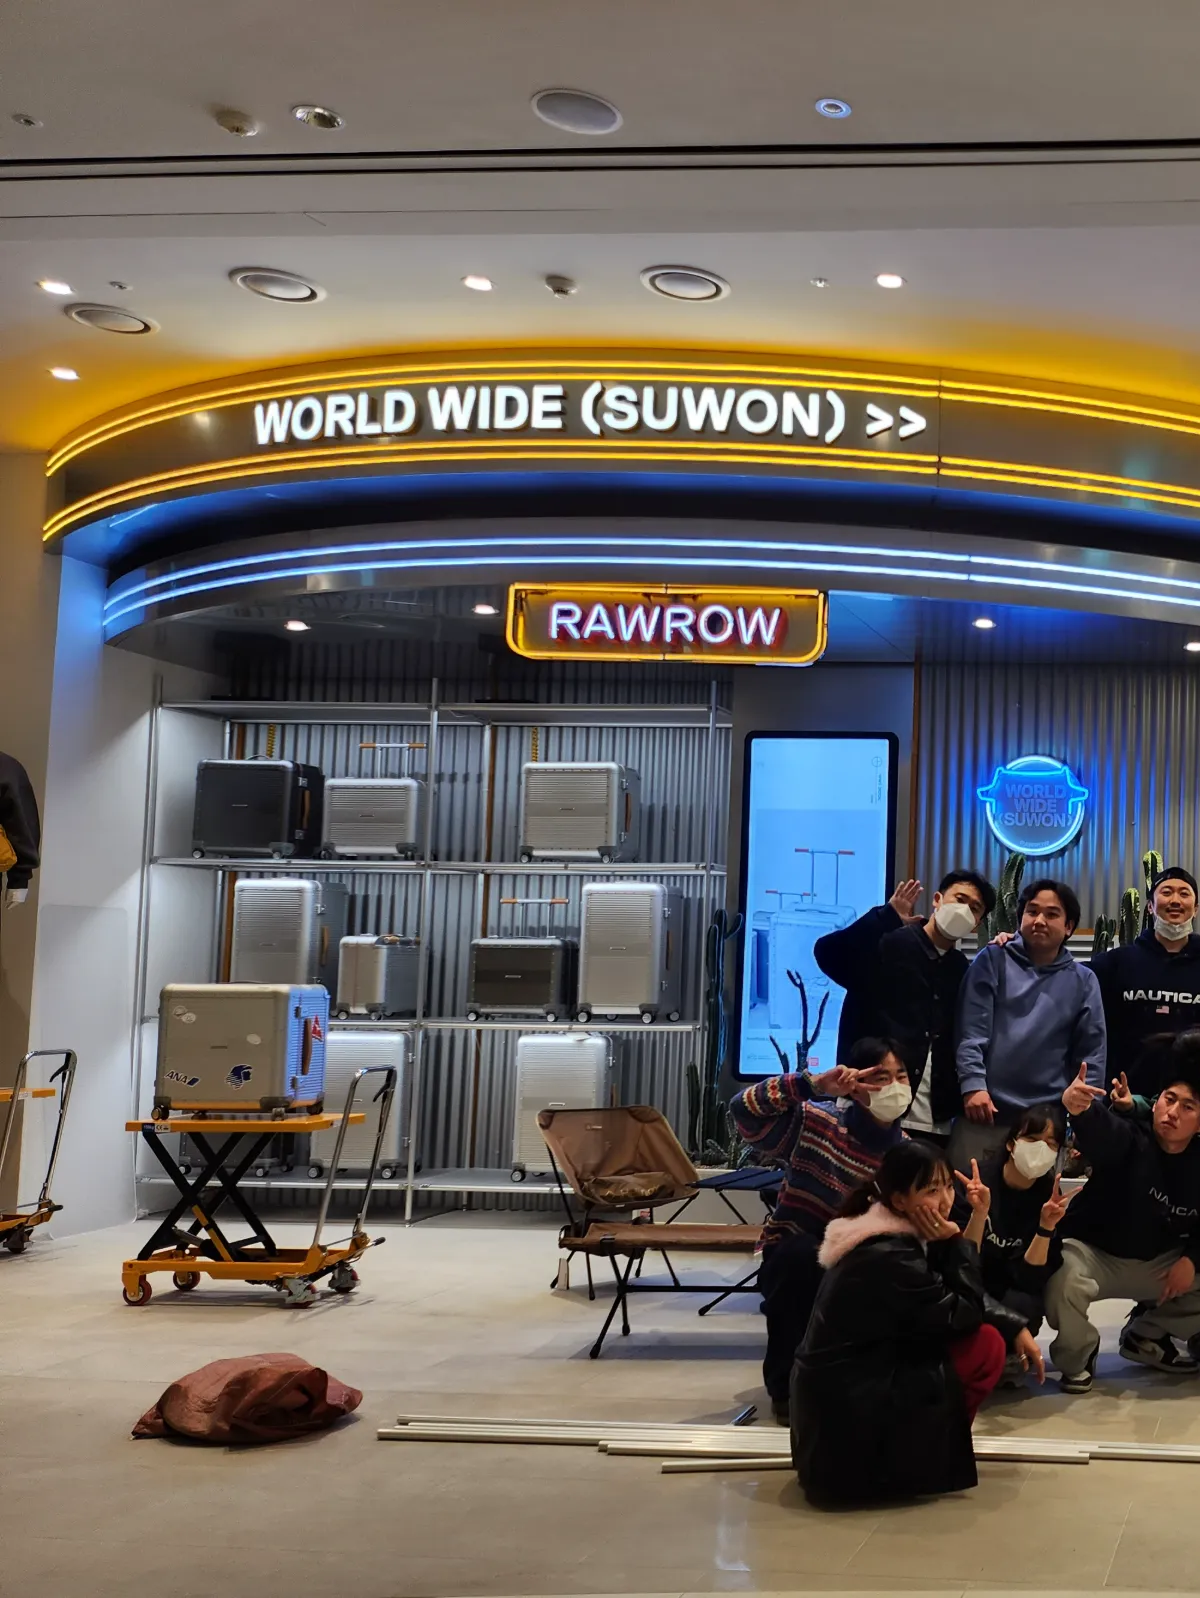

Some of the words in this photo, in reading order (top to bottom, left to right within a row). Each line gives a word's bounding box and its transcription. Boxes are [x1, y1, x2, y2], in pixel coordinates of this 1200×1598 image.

[253, 389, 417, 446] WORLD
[427, 384, 564, 431] WIDE
[581, 381, 846, 444] (SUWON)
[550, 601, 781, 645] RAWROW
[1005, 784, 1066, 799] WORLD
[1014, 799, 1057, 812] WIDE
[165, 1070, 188, 1085] ANA
